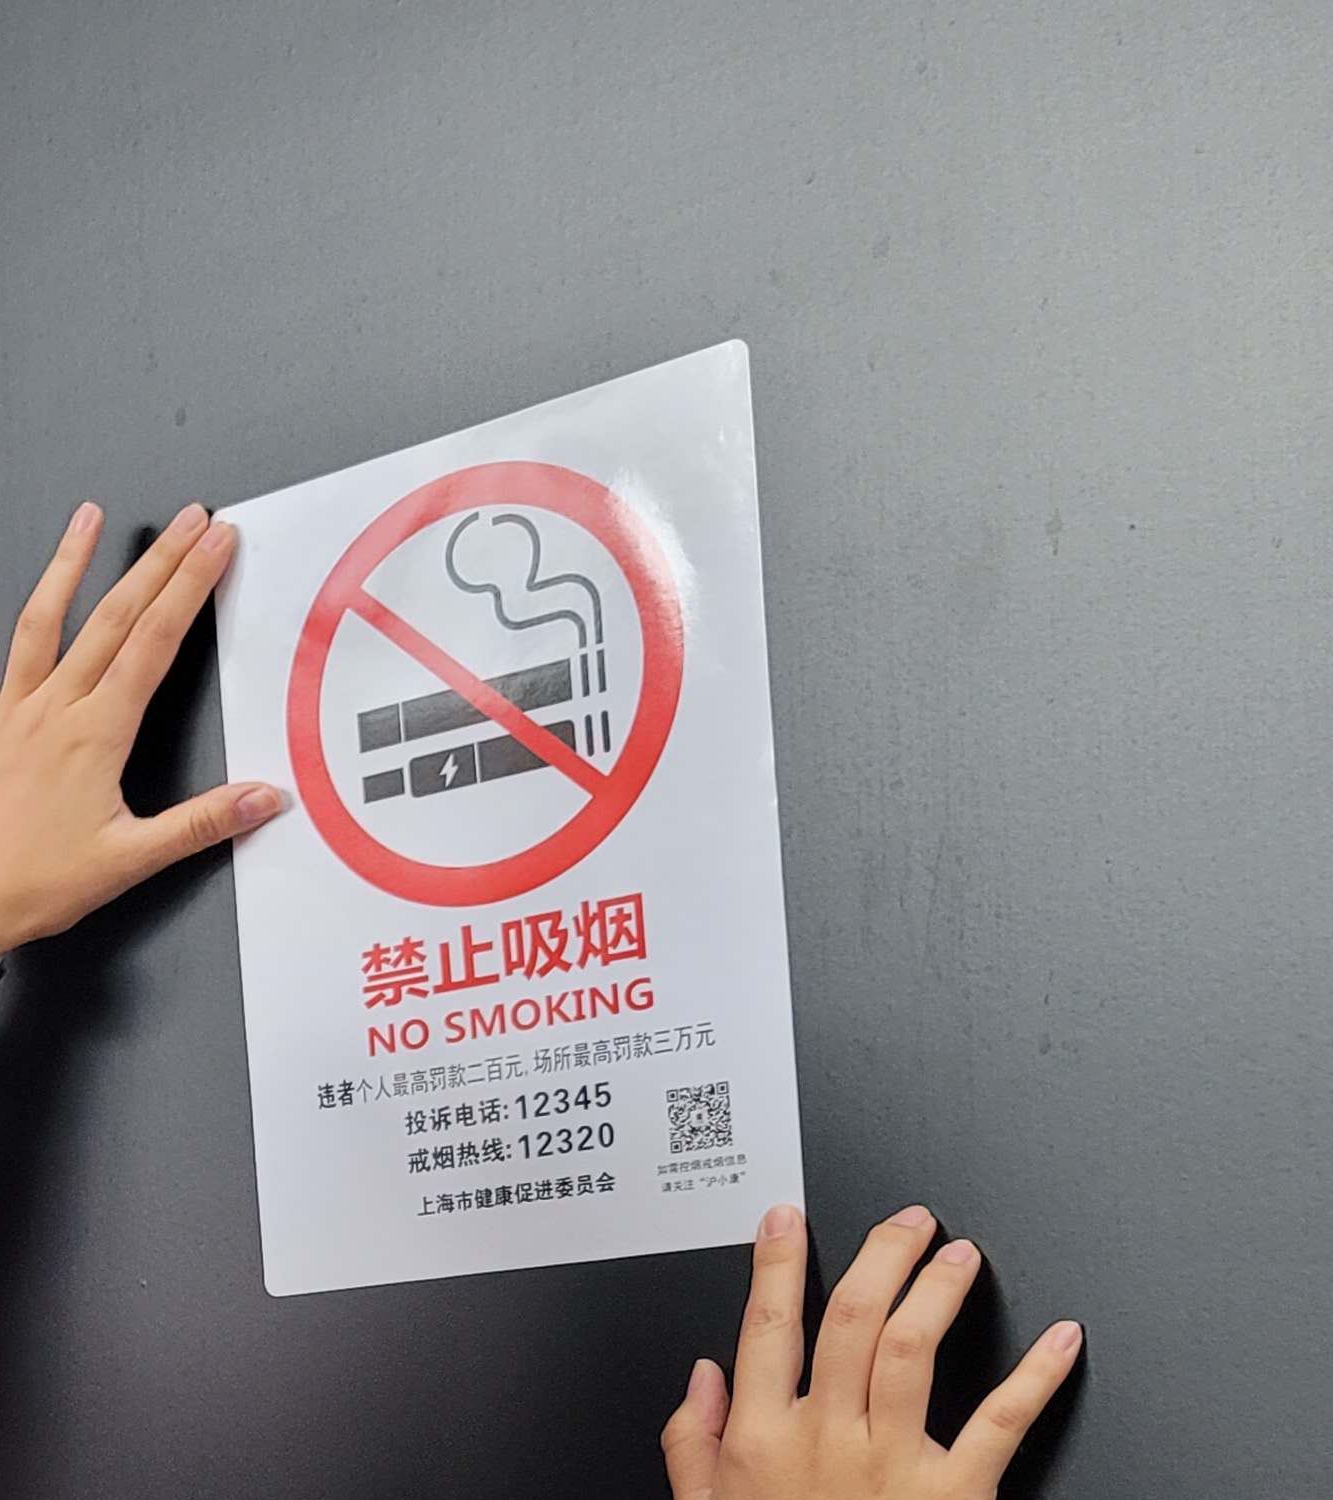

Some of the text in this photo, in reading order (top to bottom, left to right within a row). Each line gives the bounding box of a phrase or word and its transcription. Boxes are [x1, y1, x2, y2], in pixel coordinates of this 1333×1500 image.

[361, 893, 647, 1009] 禁止吸烟
[367, 977, 655, 1056] NO SMOKING
[417, 1171, 616, 1216] 上海市健康促进委员会
